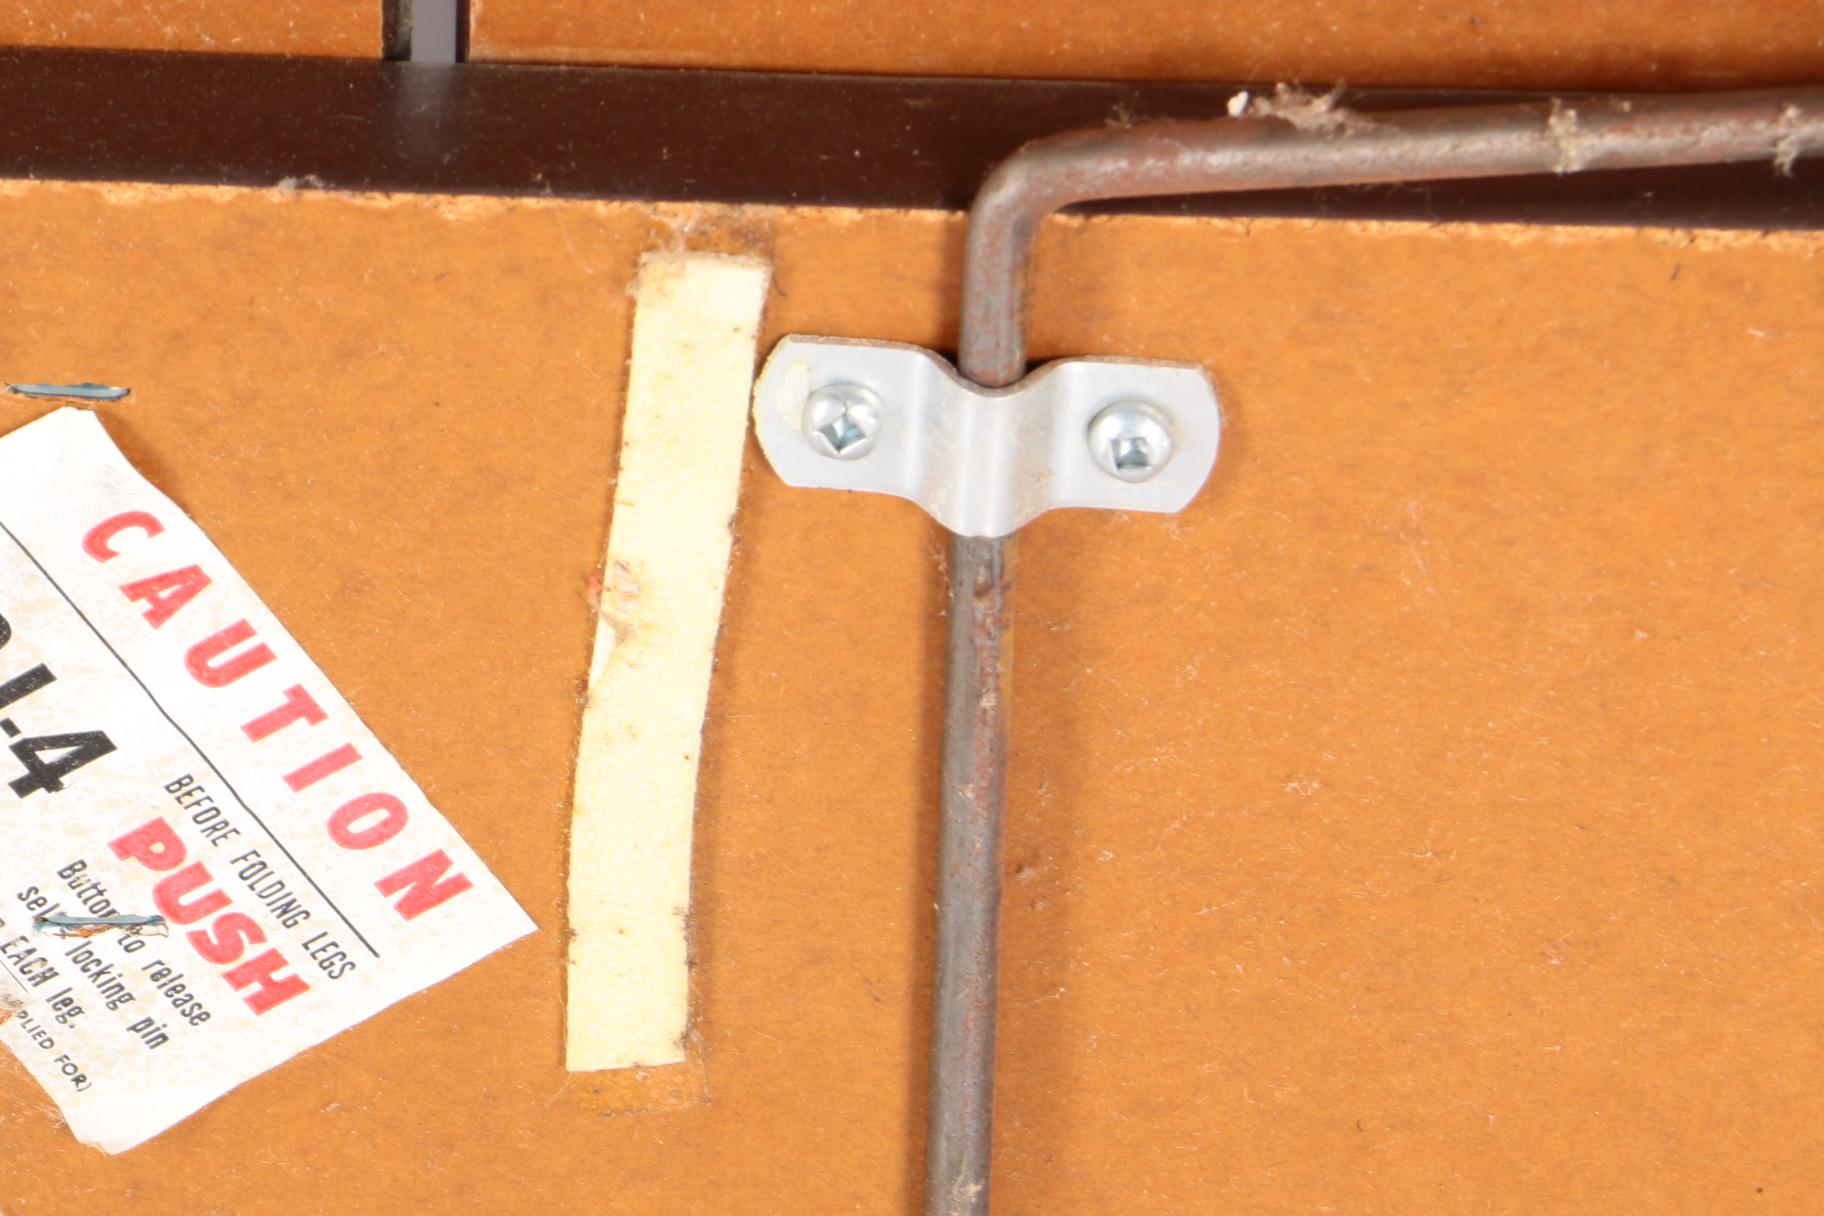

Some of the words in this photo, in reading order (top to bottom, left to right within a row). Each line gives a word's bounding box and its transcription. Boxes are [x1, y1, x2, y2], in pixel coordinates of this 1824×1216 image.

[82, 510, 474, 921] CAUTION
[107, 816, 311, 1016] PUSH
[164, 774, 241, 847] BEFORE
[230, 849, 310, 929] FOLDING
[302, 931, 356, 980] LEGS
[0, 935, 59, 988] EACH
[46, 987, 85, 1029] leg.
[141, 959, 212, 1026] release
[54, 1053, 92, 1092] FOR)
[126, 1016, 170, 1050] pin
